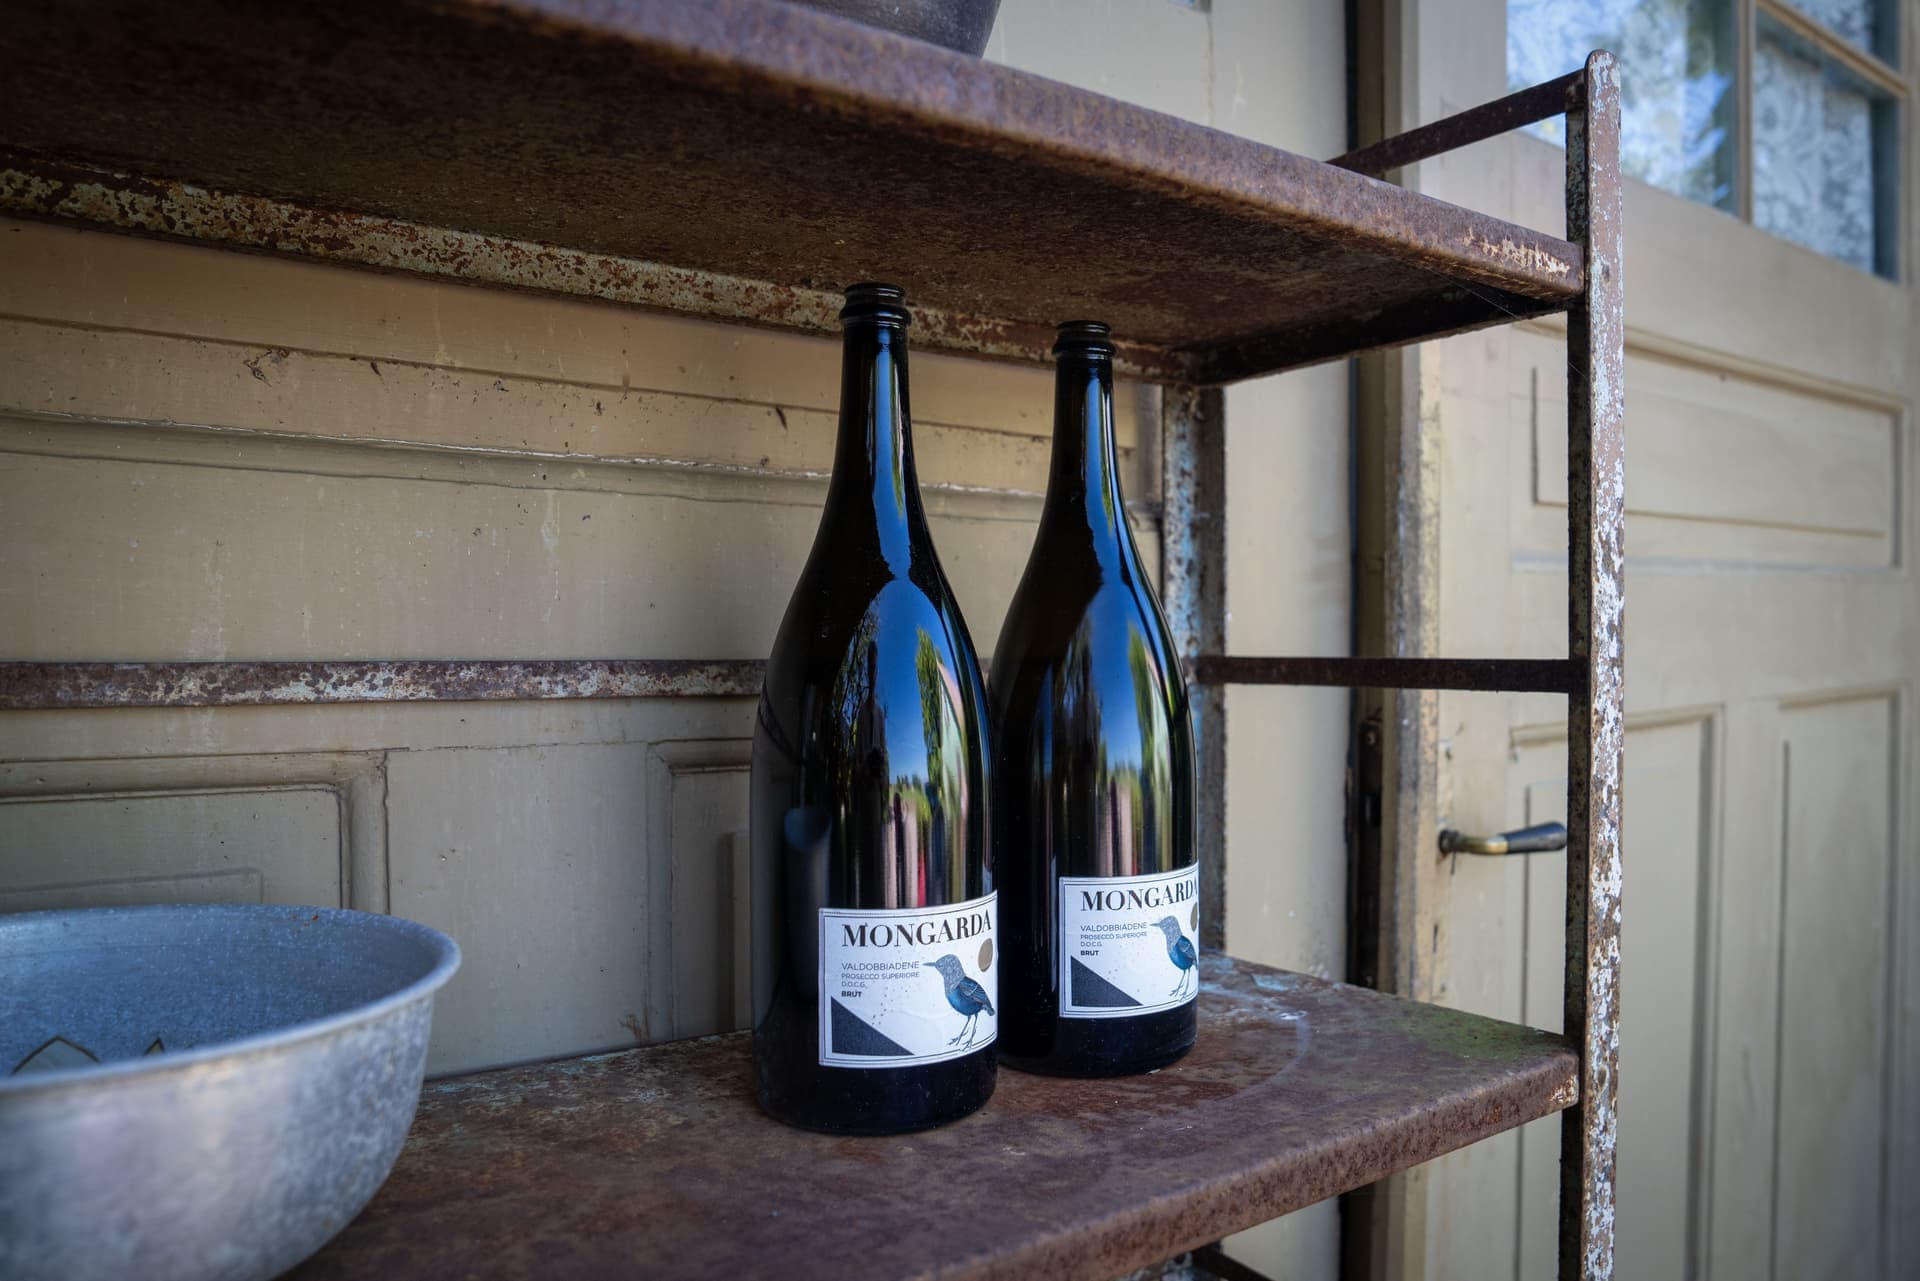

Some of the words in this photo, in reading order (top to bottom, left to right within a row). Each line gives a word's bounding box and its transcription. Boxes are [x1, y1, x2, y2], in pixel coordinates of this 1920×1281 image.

[842, 909, 992, 947] MONGARDA
[1080, 922, 1147, 932] VALDOBBIADENE
[841, 961, 919, 971] VALDOBBIADENE
[881, 972, 919, 980] SUPERIORE
